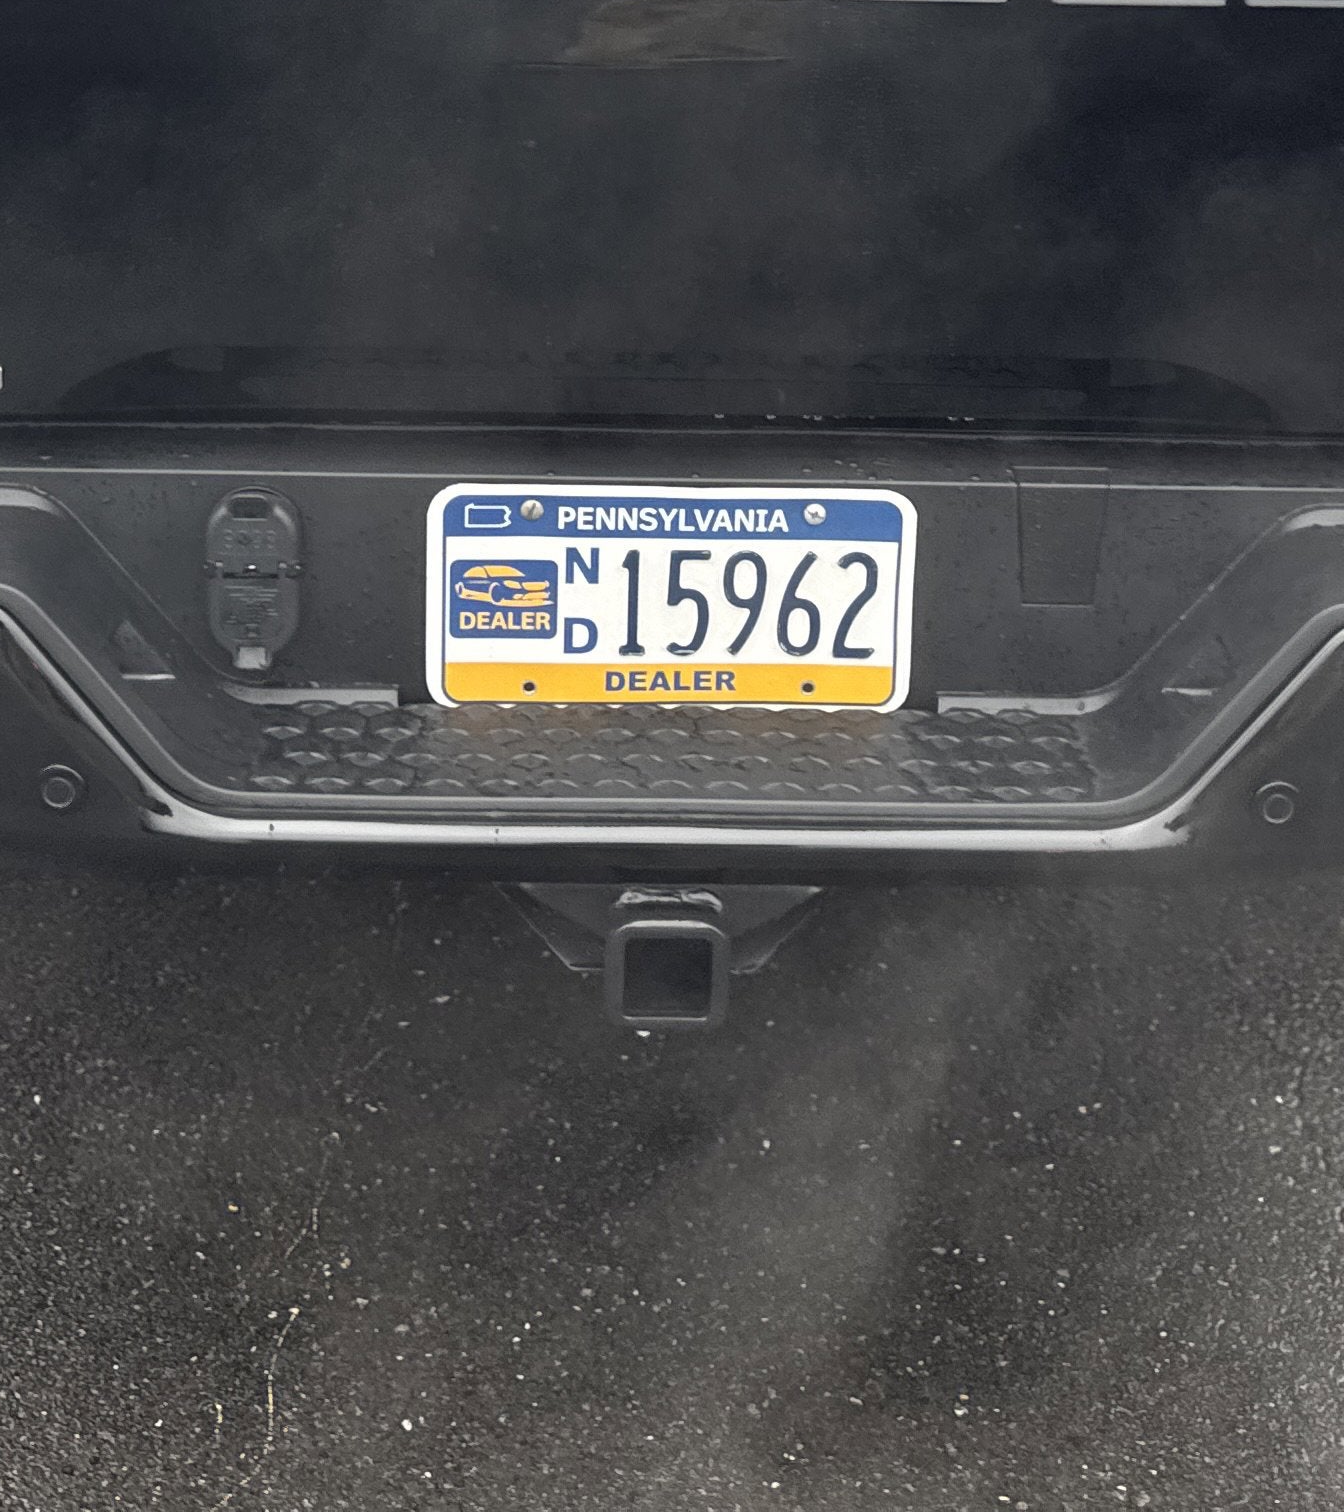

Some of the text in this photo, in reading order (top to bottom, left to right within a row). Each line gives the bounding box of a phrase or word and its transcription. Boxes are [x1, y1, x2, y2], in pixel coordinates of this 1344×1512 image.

[557, 505, 789, 534] PENNSYLVANIA
[617, 549, 881, 660] 15962
[459, 611, 551, 631] DEALER
[604, 669, 736, 693] DEALER
